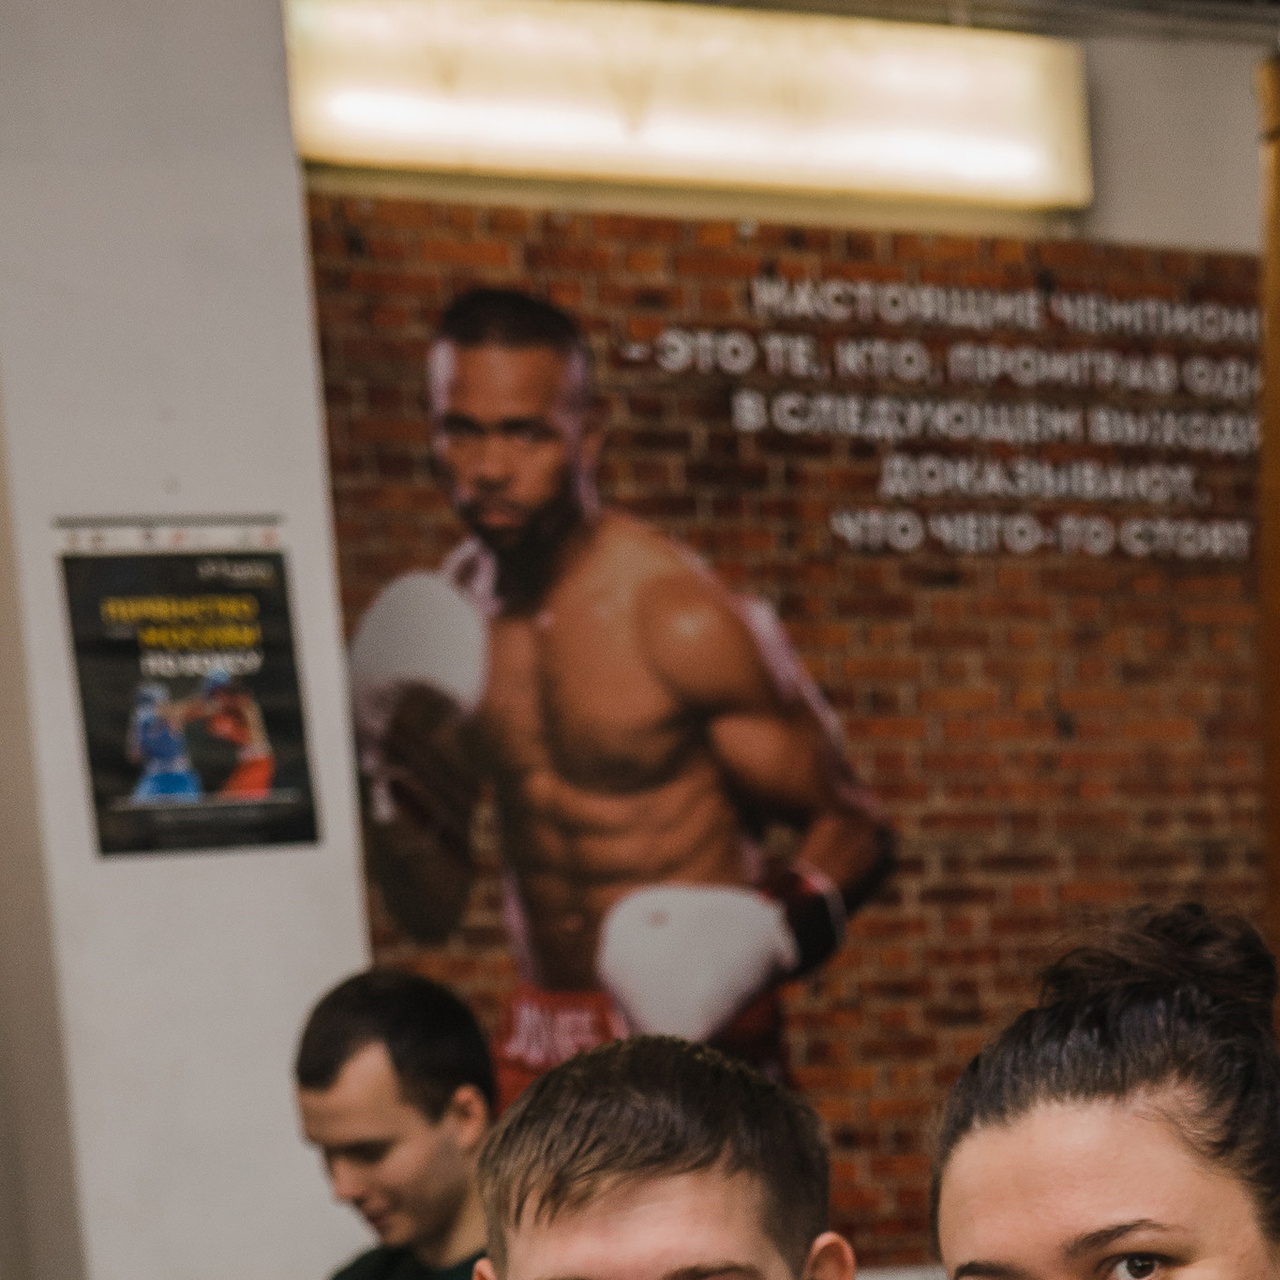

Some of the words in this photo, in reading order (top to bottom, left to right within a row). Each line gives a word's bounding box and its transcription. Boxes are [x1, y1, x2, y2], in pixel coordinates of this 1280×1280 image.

[752, 278, 1043, 330] НАСТОЯЩИЕ
[1049, 292, 1260, 344] ЧЕМПИОН
[656, 329, 759, 374] ЭТО
[948, 344, 1178, 396] ПРОИГРАВ
[731, 389, 767, 433] В
[772, 392, 1083, 444] СЛЕДУЮЩЕМ
[829, 508, 926, 552] ЧТО
[928, 511, 1116, 556] ЧЕГО-ТО
[1120, 517, 1252, 561] СТОЯТ
